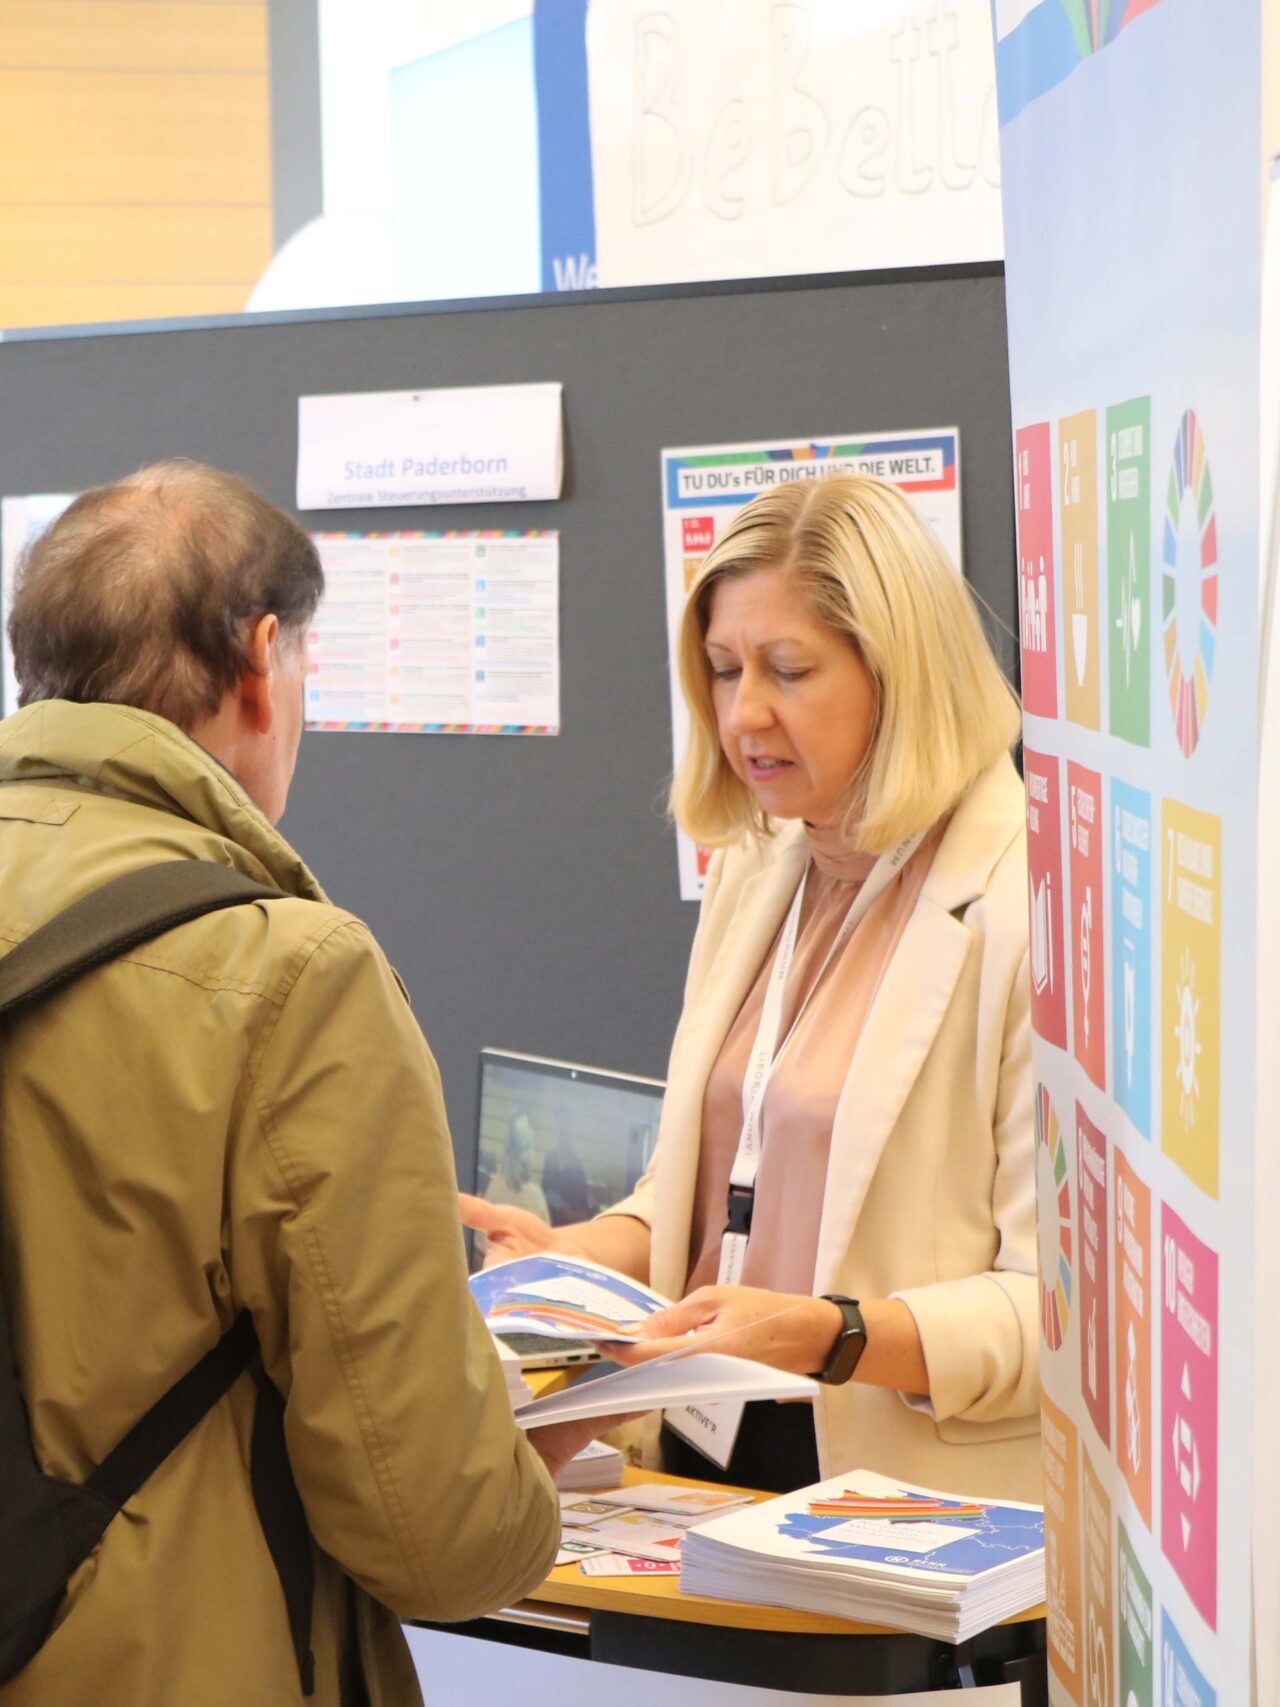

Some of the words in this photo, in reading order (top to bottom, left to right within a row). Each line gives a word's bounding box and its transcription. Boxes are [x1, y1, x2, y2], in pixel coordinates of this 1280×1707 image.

[343, 460, 396, 481] Stadt
[402, 454, 509, 478] Paderborn
[684, 474, 704, 490] TU
[744, 466, 775, 486] FÜR
[780, 467, 816, 483] DICH
[859, 460, 885, 476] DIE
[889, 456, 936, 475] WELT.
[327, 490, 374, 505] Zentrale
